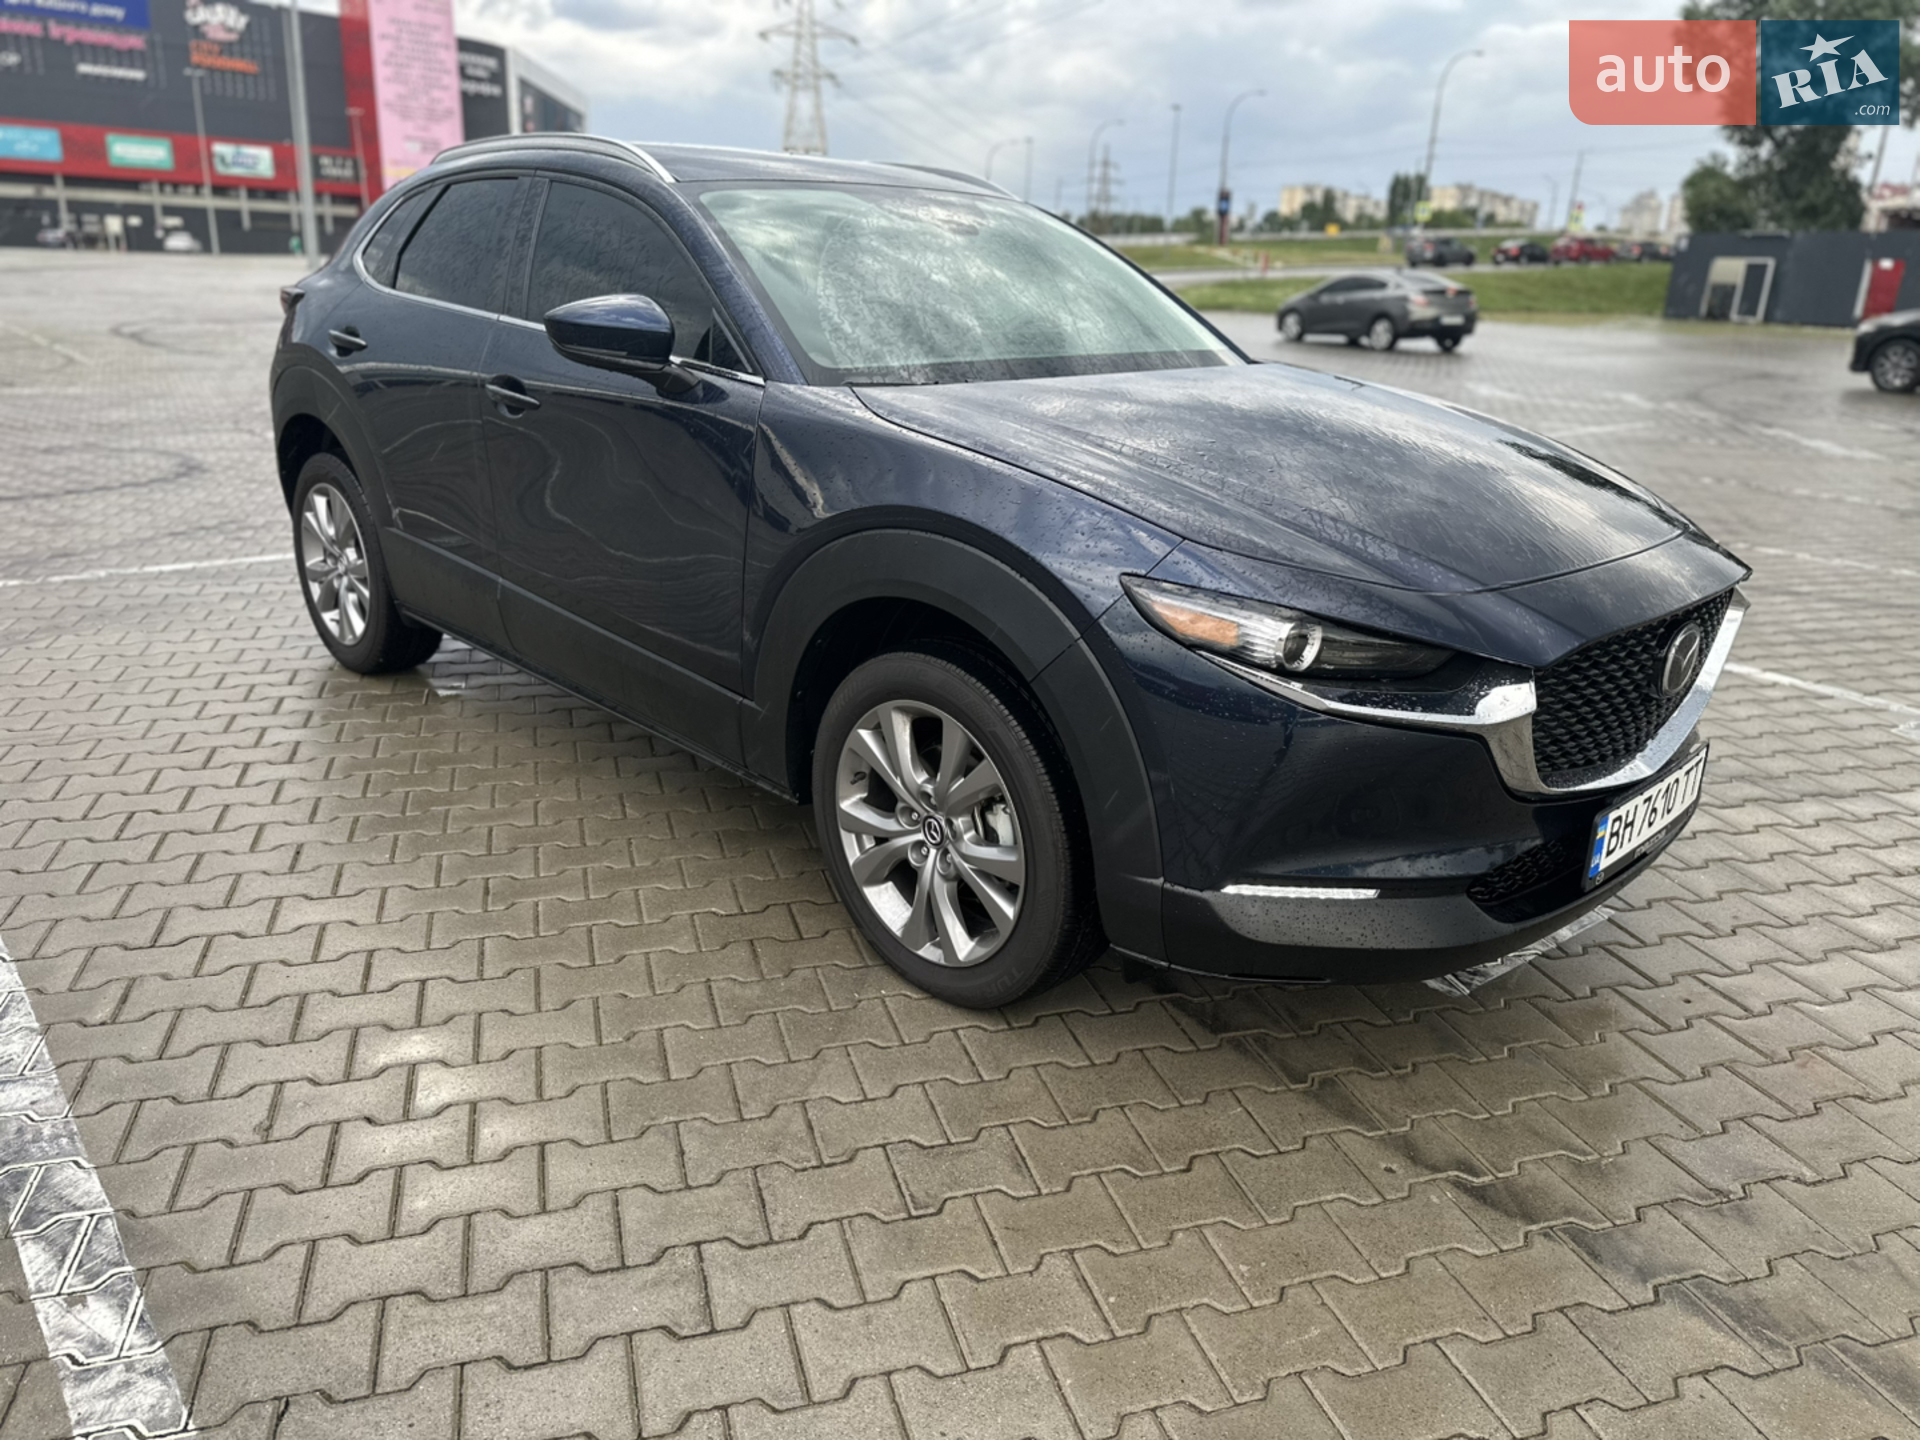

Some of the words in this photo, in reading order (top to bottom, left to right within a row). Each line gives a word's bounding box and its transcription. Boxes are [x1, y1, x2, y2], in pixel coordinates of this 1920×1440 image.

[1605, 804, 1638, 858] BH
[1637, 777, 1680, 837] 7610
[1681, 757, 1703, 804] TT
